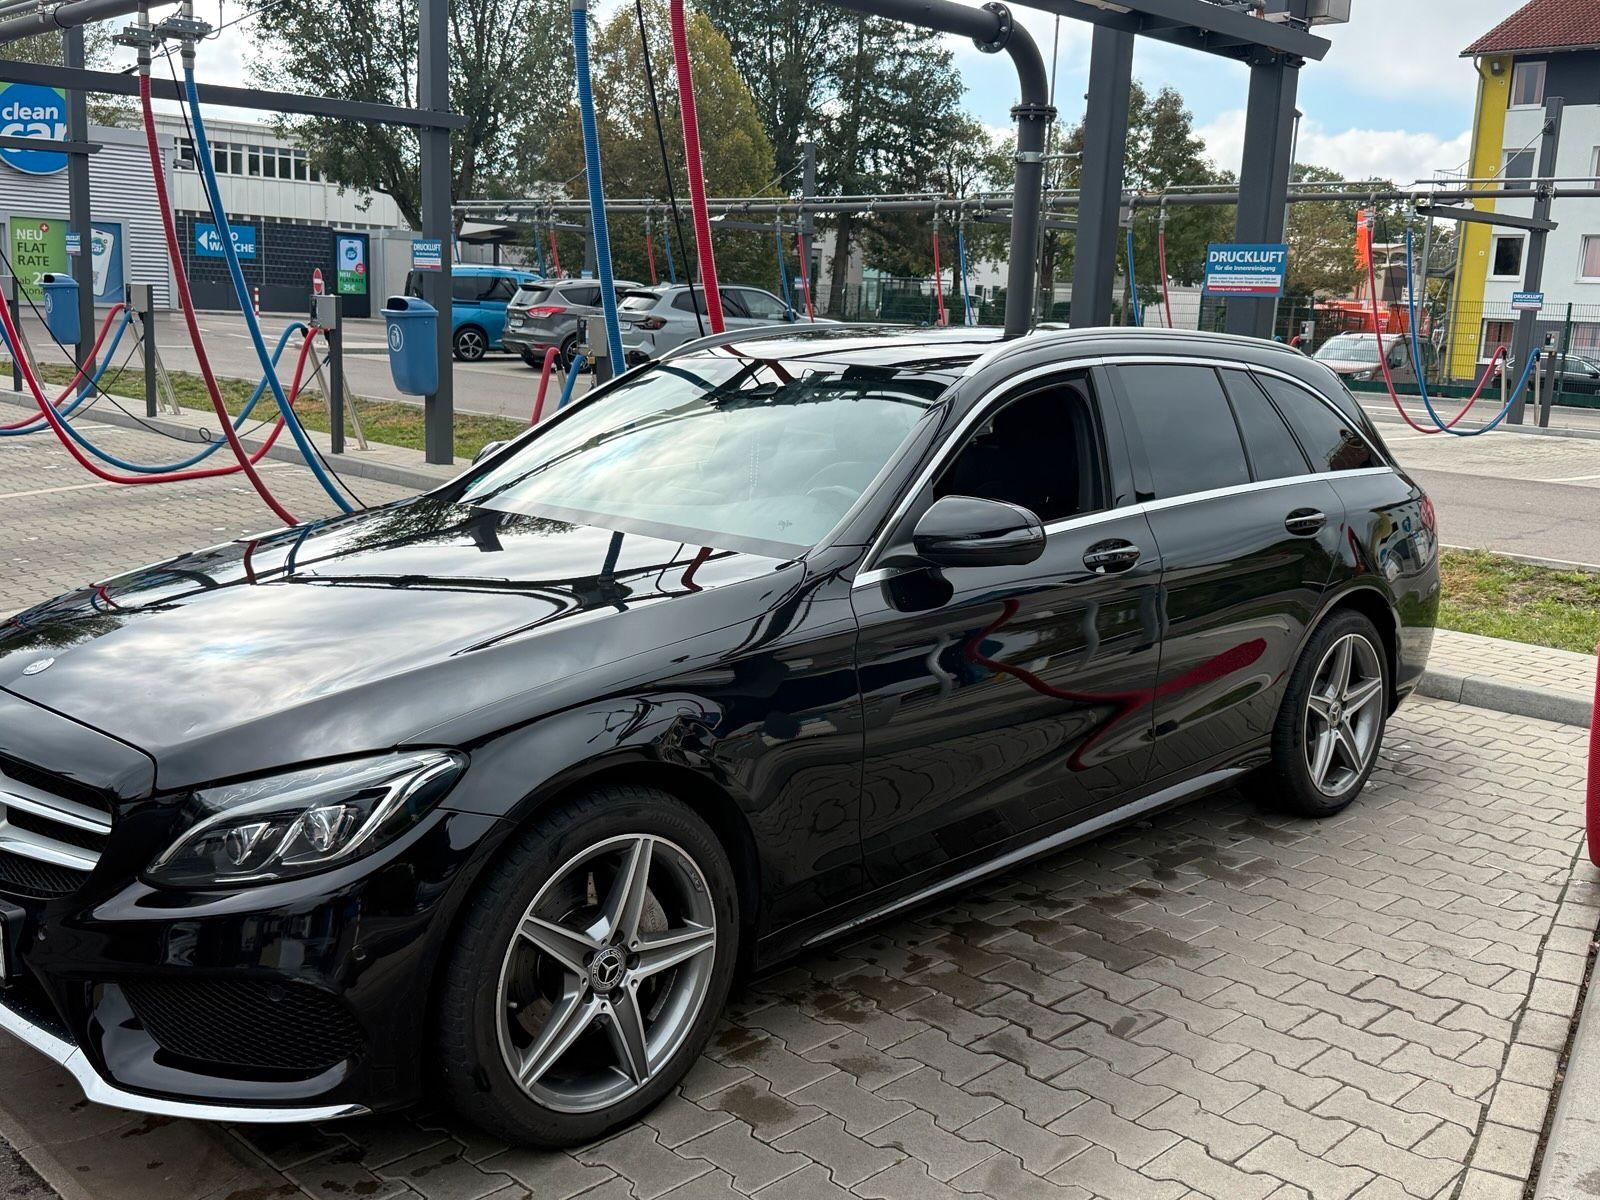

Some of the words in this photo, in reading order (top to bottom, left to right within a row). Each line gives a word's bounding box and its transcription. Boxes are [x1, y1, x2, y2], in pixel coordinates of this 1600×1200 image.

[2, 102, 58, 120] clean
[16, 229, 42, 240] NEU
[209, 231, 238, 241] AO
[17, 242, 47, 253] FLAT
[209, 242, 255, 252] WCHE
[18, 256, 49, 267] RATE
[1209, 251, 1284, 262] DRUCKLUFT
